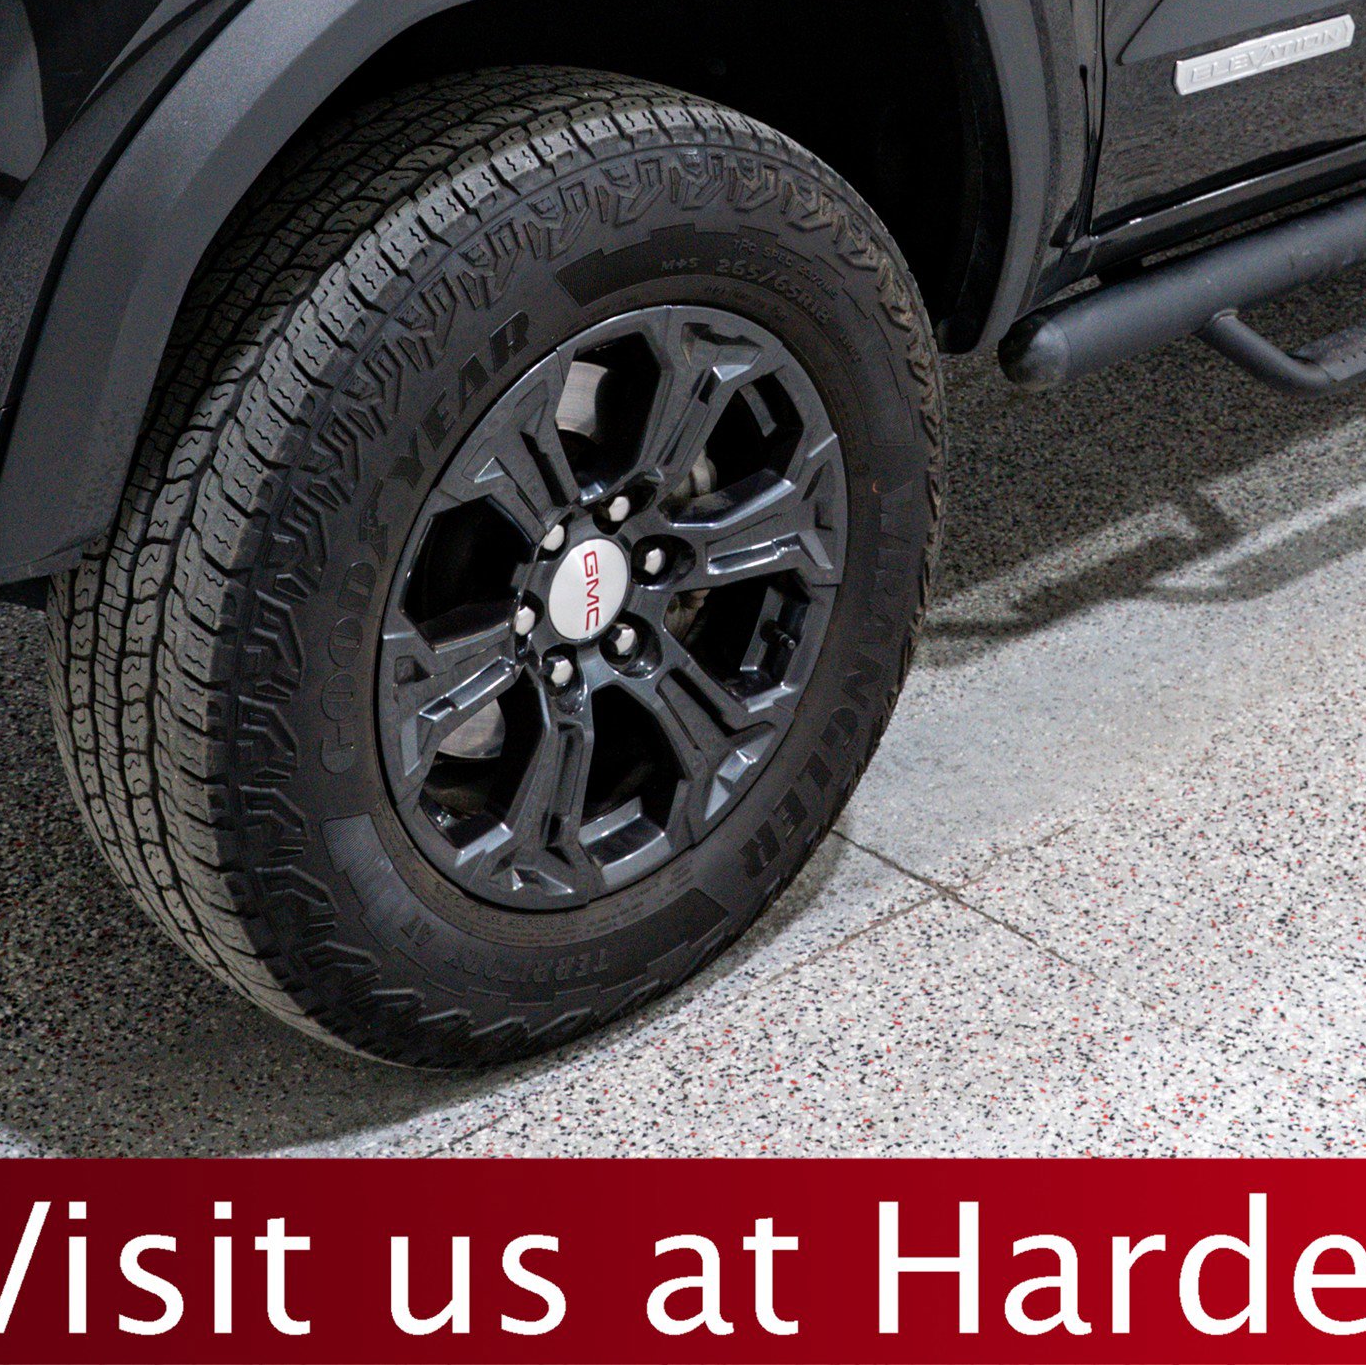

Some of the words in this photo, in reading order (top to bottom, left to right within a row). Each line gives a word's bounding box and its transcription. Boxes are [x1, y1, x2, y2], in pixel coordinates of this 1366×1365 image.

[1189, 28, 1338, 84] ELEVATION
[763, 246, 792, 267] SPEC
[715, 259, 831, 325] 265/65R18
[584, 550, 600, 631] GMC
[739, 481, 915, 880] WRANGLER
[444, 947, 611, 984] TERRITORY
